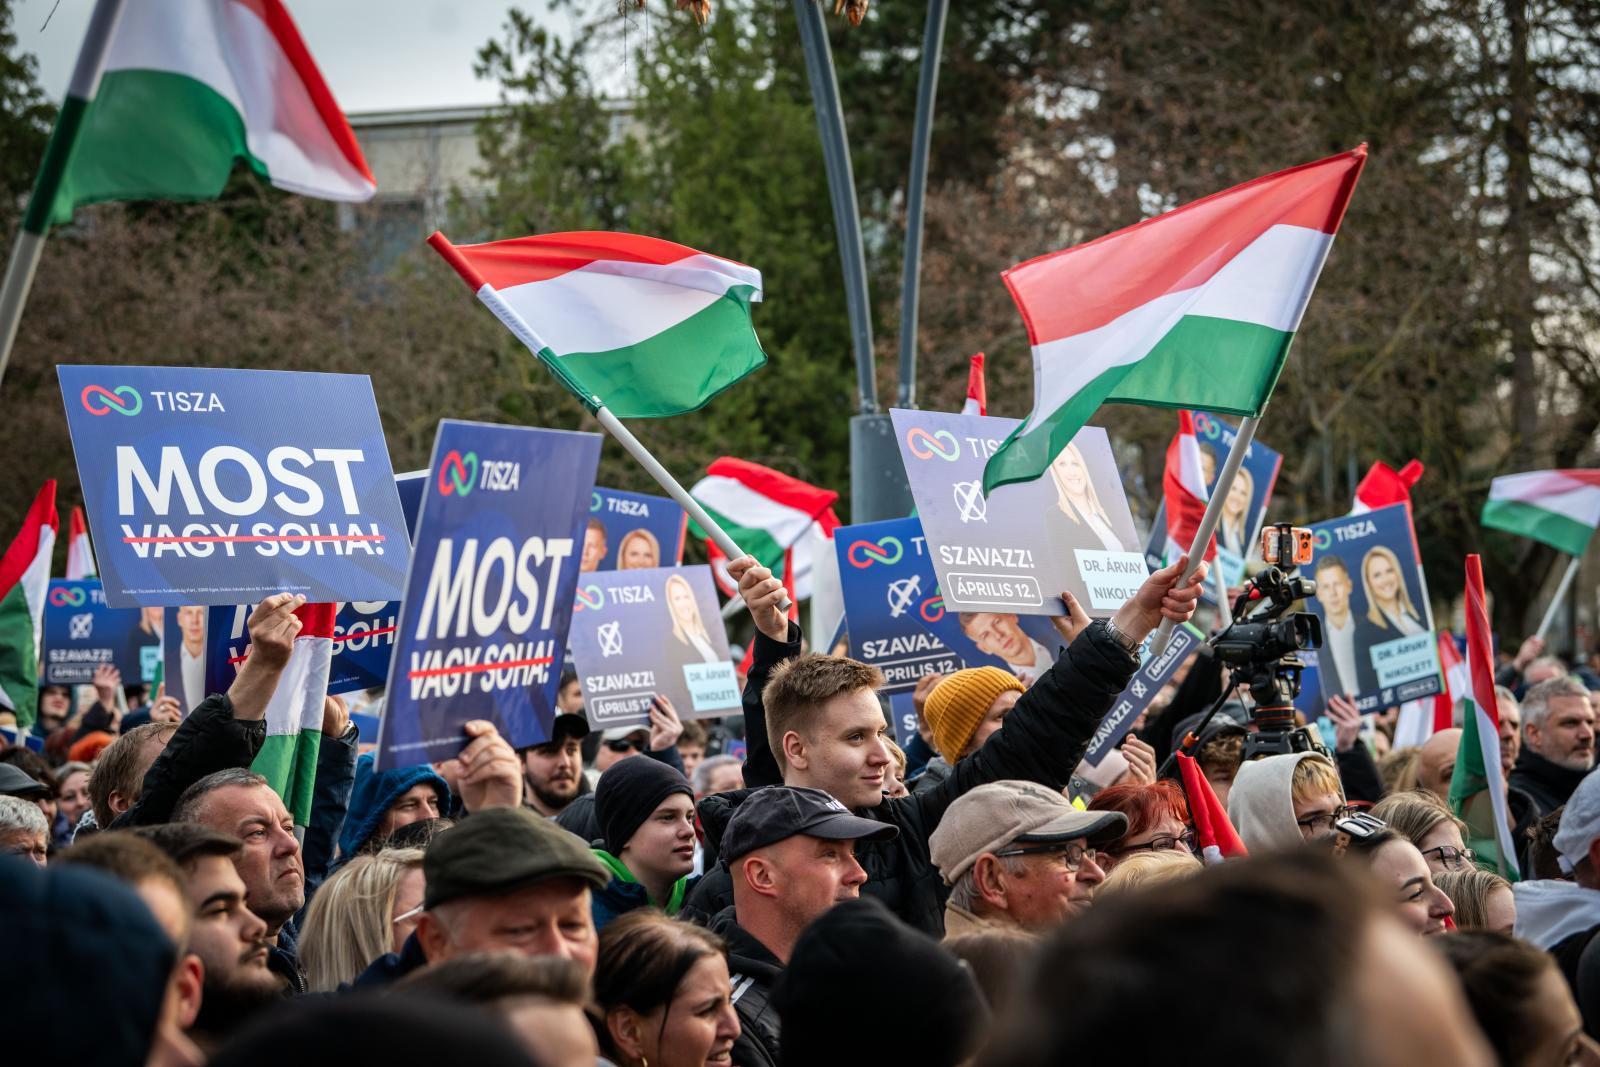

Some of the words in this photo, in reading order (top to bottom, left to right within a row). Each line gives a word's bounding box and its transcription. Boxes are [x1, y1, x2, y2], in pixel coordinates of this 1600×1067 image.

[151, 391, 225, 413] TISZA
[116, 445, 365, 516] MOST
[480, 460, 521, 492] TISZA
[606, 497, 649, 517] TISZA
[121, 523, 239, 558] VAGY
[251, 523, 385, 557] SOHA!
[1333, 520, 1378, 543] TISZA
[939, 545, 1036, 569] SZAVAZZ!
[1083, 559, 1104, 572] DR.
[1106, 558, 1142, 575] ÁRVAY
[415, 536, 574, 641] MOST
[608, 585, 655, 605] TISZA
[957, 577, 1013, 598] ÁPRILIS
[1014, 583, 1035, 598] 12.
[1093, 586, 1141, 600] NIKOLE
[332, 615, 396, 656] SOH
[862, 633, 944, 659] SZAVAZ
[409, 647, 481, 701] VAGY
[480, 640, 554, 693] SOHA!
[882, 663, 935, 682] PRILIS
[937, 659, 959, 674] 12.
[1150, 646, 1178, 677] ÁPRILIS
[586, 670, 656, 693] SZAVAZZ!
[689, 671, 704, 682] DR.
[598, 698, 641, 717] ÁPRILIS
[695, 689, 736, 703] NIKOLETT
[1086, 700, 1134, 756] SZAVAZZ!
